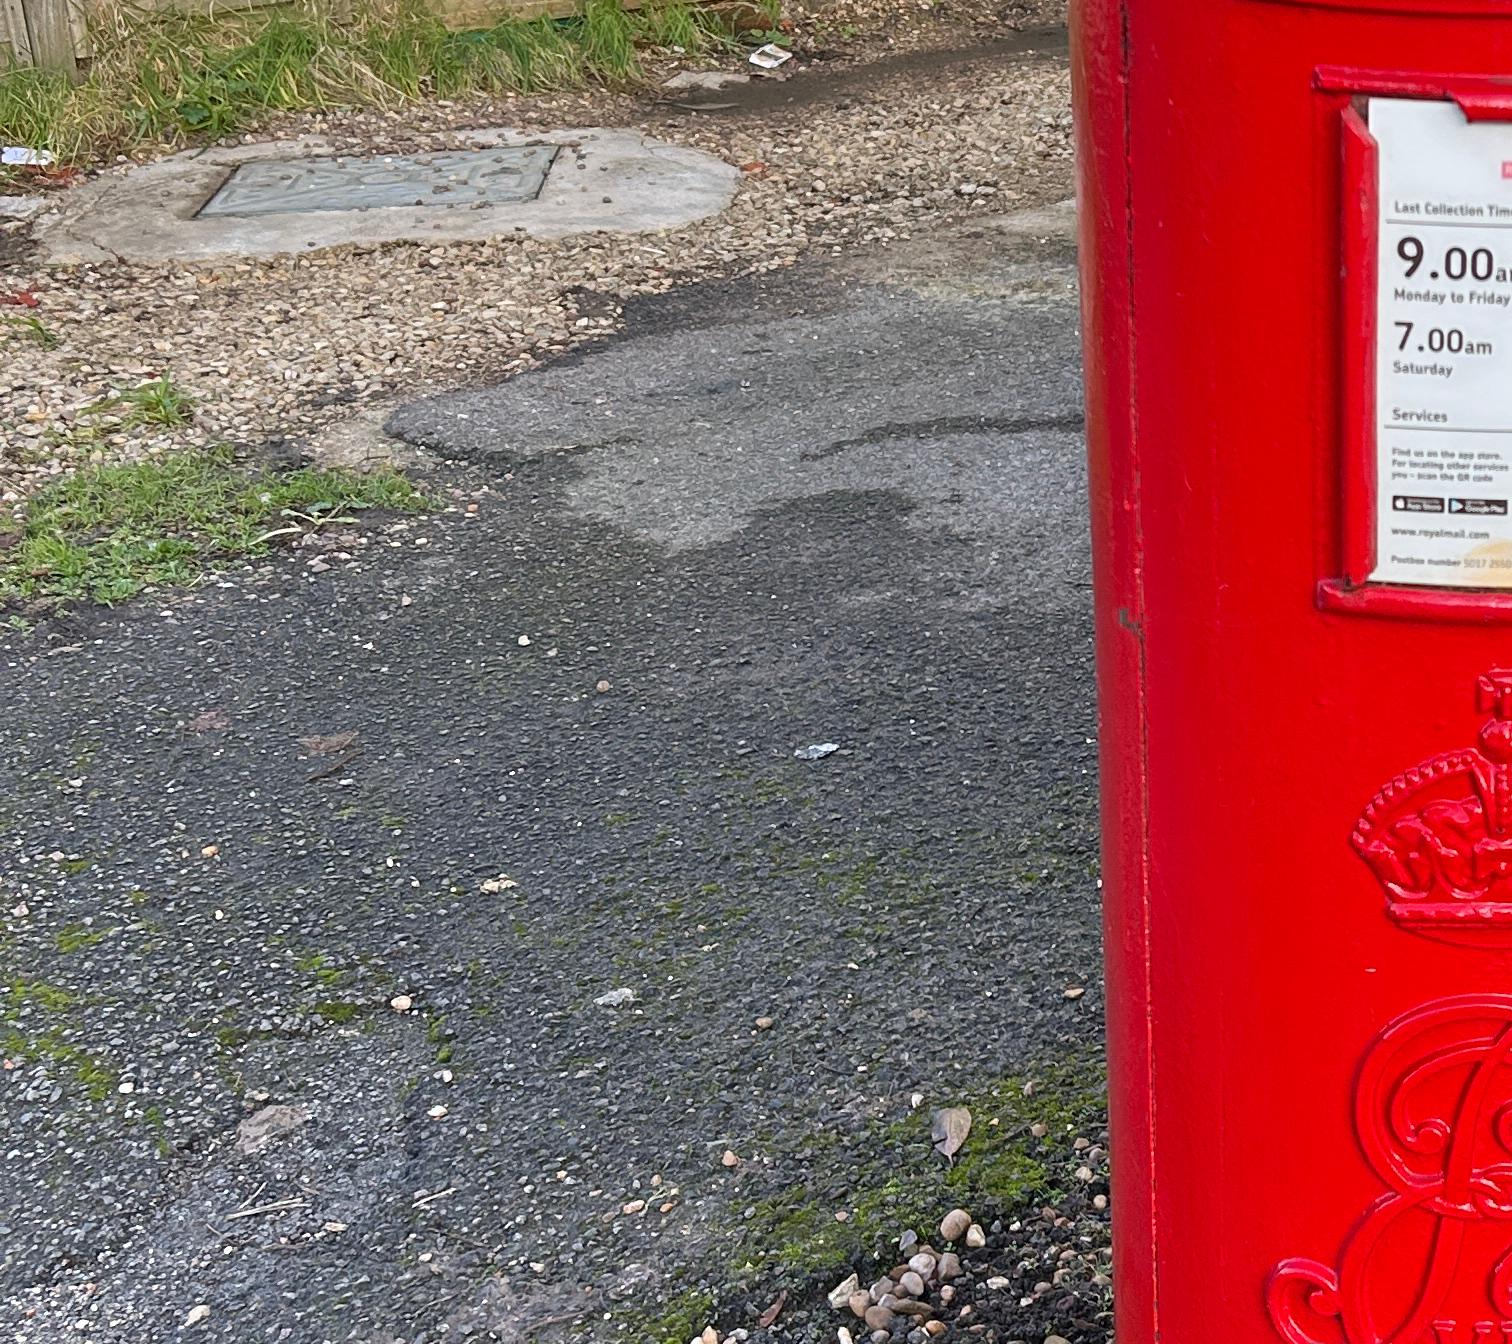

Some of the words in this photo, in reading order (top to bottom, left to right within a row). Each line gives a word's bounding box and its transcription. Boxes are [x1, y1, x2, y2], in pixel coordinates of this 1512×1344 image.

[1394, 200, 1420, 214] Last
[1424, 201, 1484, 217] Collection
[1393, 288, 1446, 305] Monday
[1450, 291, 1465, 304] to
[1469, 291, 1512, 307] Friday
[1393, 320, 1493, 355] 7.00am
[1392, 359, 1454, 378] Saturday
[1391, 406, 1449, 423] Services
[1391, 447, 1411, 457] Find
[1413, 450, 1424, 458] us
[1427, 450, 1439, 458] on
[1440, 449, 1456, 459] the
[1391, 458, 1407, 468] For
[1446, 462, 1471, 471] other
[1391, 471, 1408, 481] you
[1440, 472, 1455, 482] the
[1391, 527, 1490, 539] www.royalmail.com
[1427, 558, 1461, 567] number
